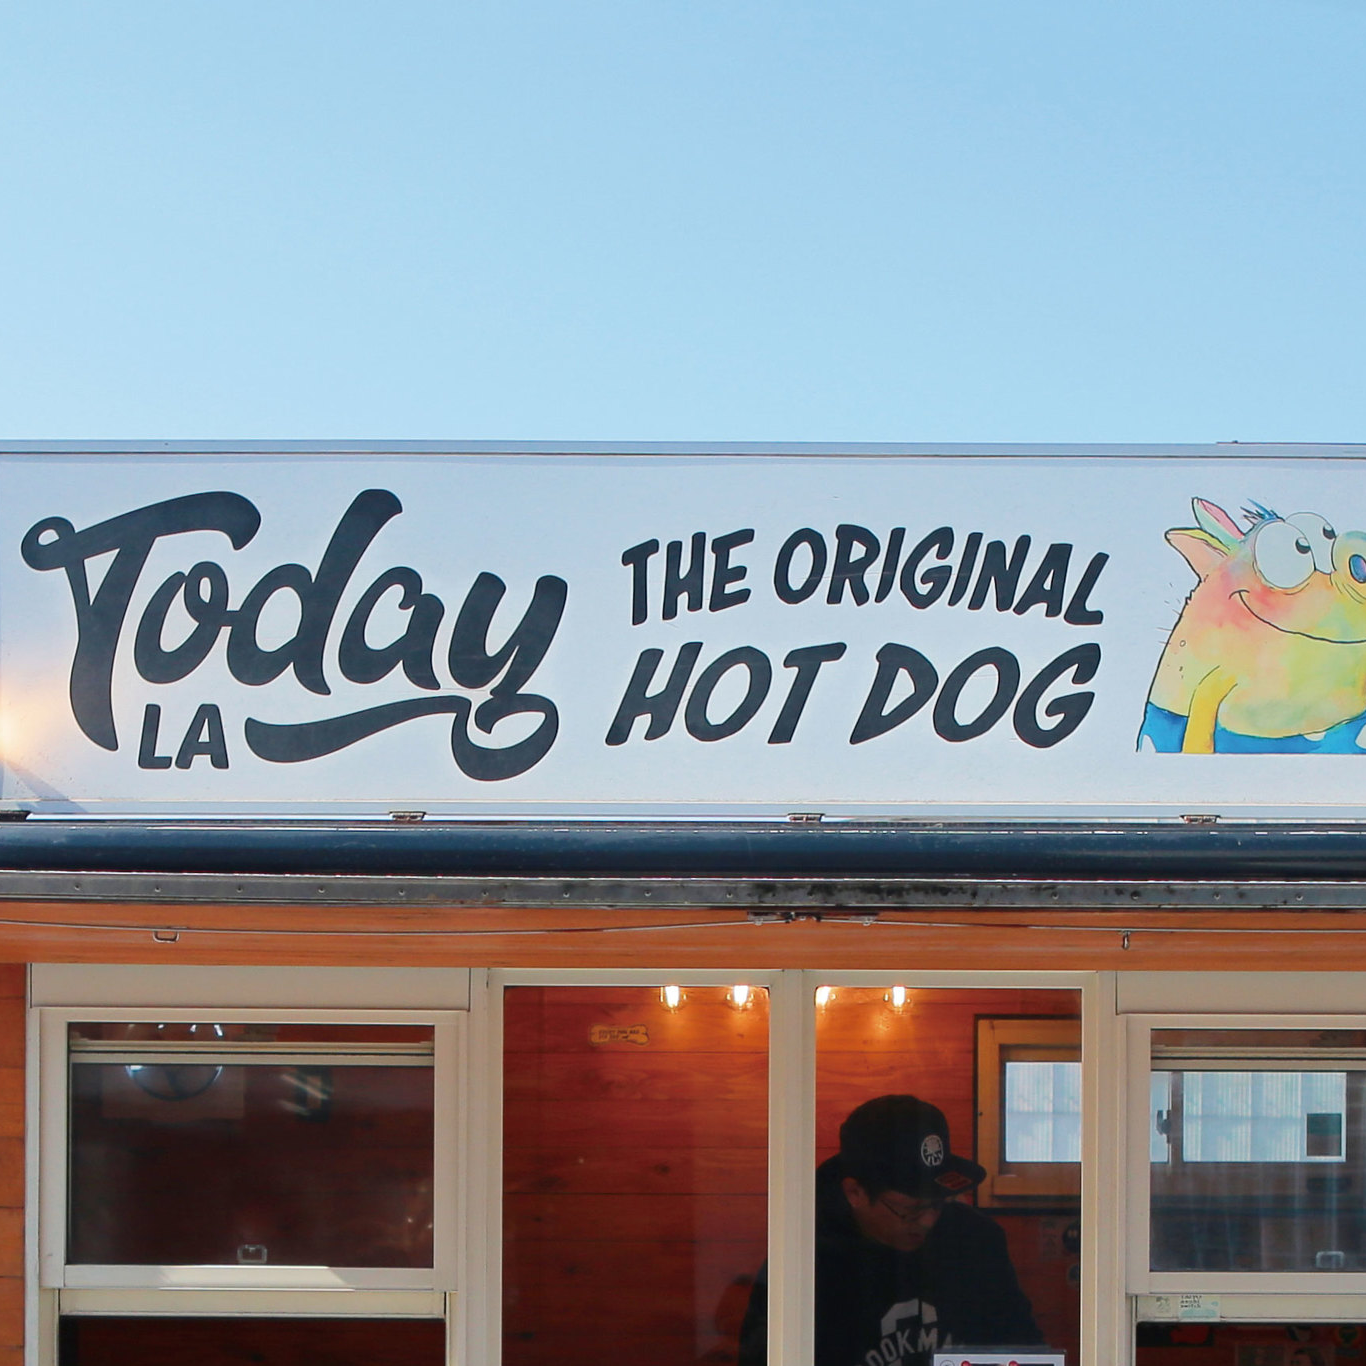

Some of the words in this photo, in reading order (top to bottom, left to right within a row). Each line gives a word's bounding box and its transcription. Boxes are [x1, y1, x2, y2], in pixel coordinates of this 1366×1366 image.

[622, 529, 755, 626] THE
[774, 524, 1110, 626] ORIGINAL
[21, 488, 568, 782] Today
[138, 704, 229, 770] LA
[605, 642, 846, 747] HOT
[850, 643, 1103, 749] DOG
